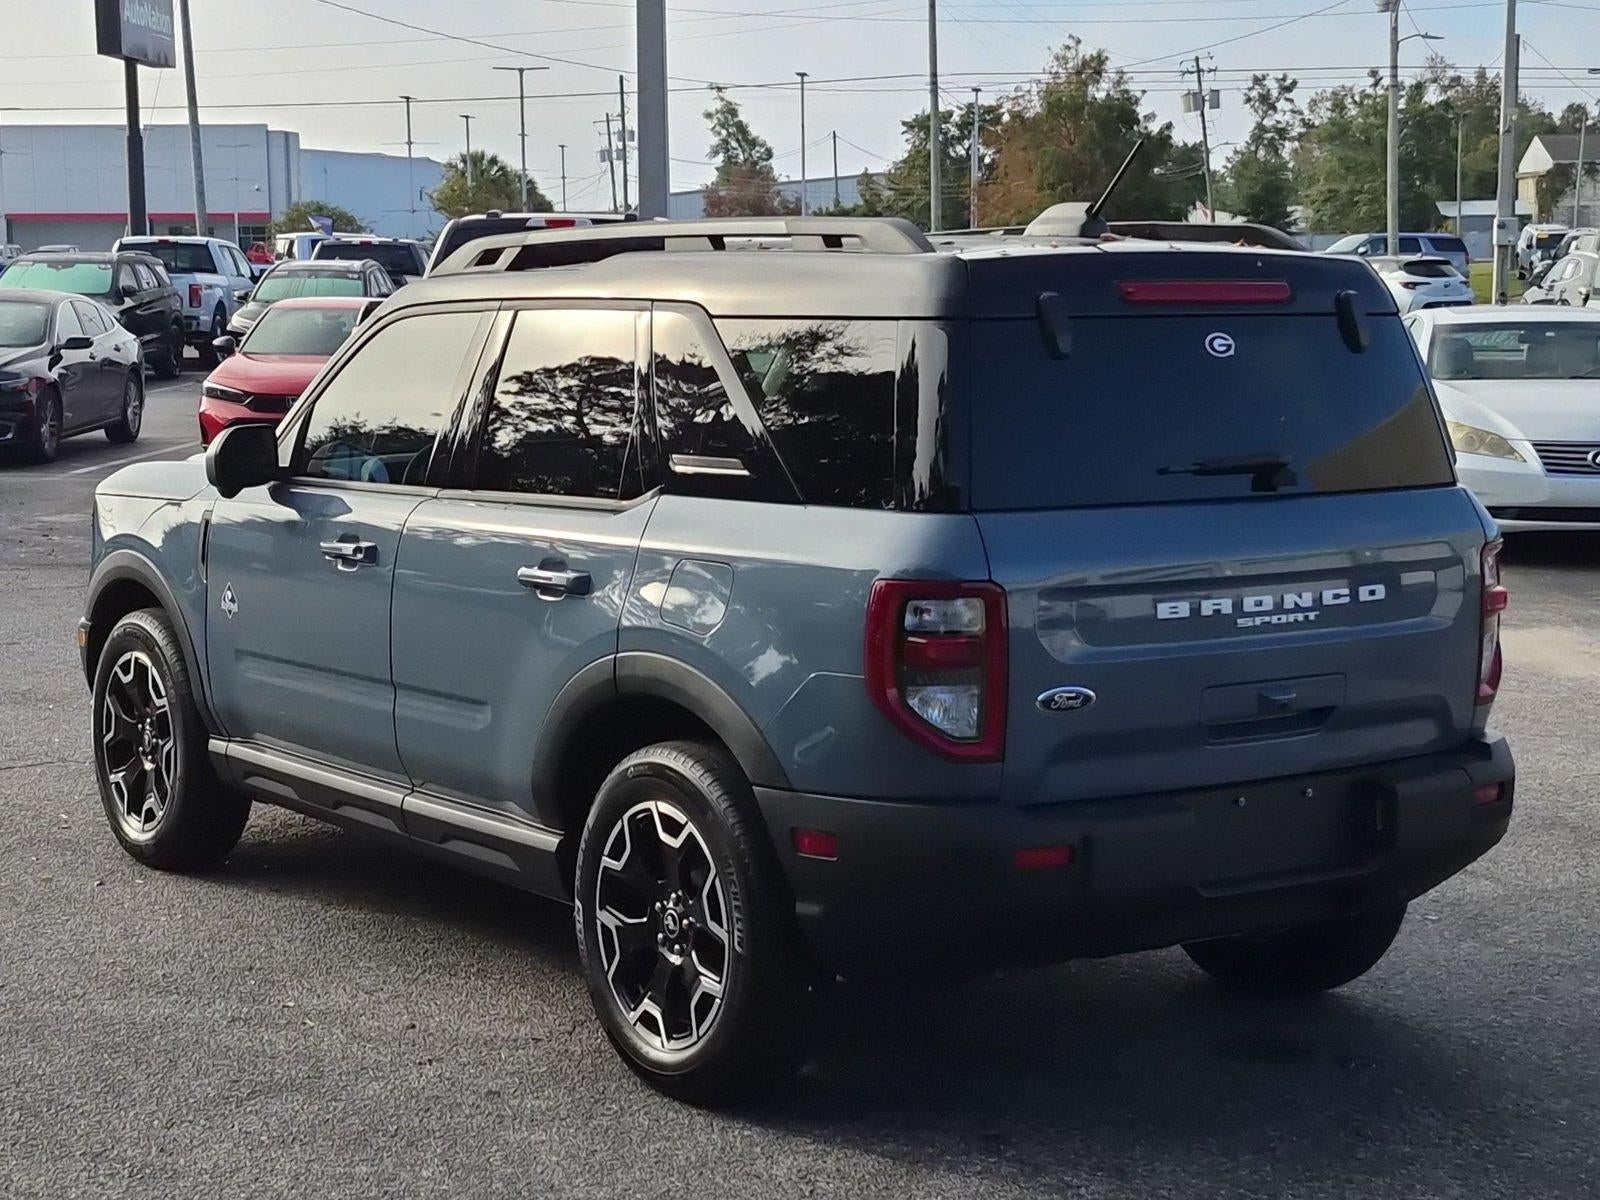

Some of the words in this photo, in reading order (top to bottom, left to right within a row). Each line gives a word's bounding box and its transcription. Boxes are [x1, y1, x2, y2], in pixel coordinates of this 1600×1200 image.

[123, 0, 172, 35] AutoNation
[1205, 332, 1235, 357] G
[1156, 584, 1386, 620] BRONCO
[1236, 611, 1320, 628] SPORT
[1050, 693, 1084, 709] Ford
